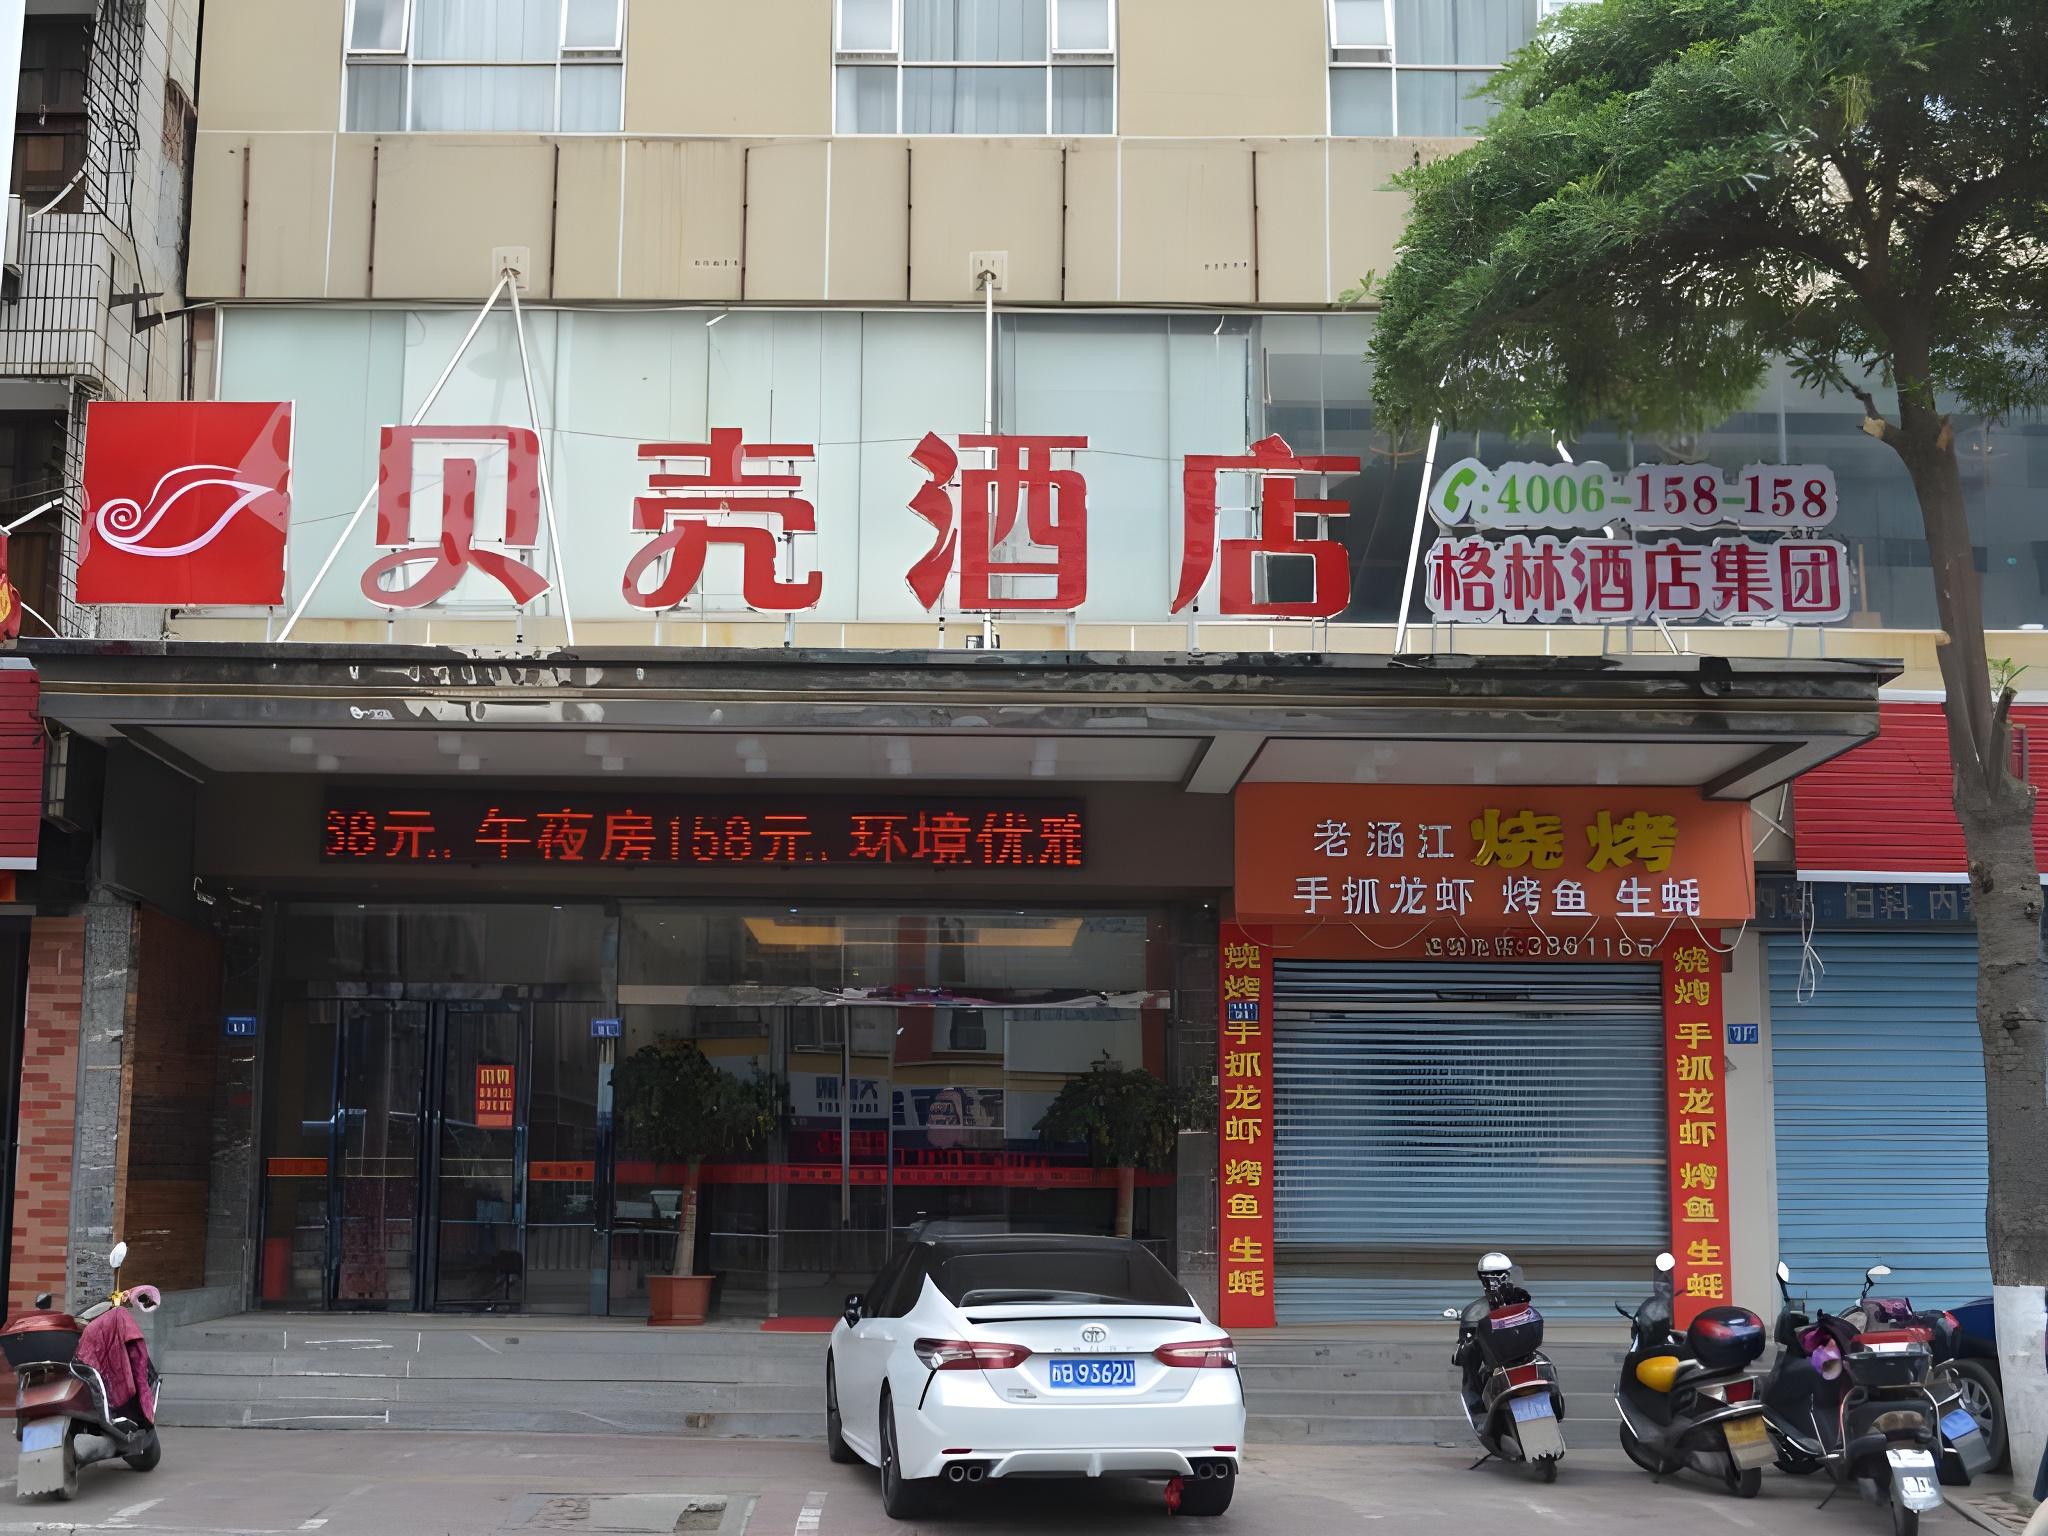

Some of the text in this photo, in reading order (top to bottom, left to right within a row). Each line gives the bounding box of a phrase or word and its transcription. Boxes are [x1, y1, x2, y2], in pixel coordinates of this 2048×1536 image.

[361, 424, 1361, 617] 贝壳酒店
[1434, 544, 1842, 613] 格林酒店集团
[1313, 808, 1680, 873] 老涵江 烧烤
[1293, 876, 1701, 917] 手抓龙虾 烤鱼 生蚝
[1224, 1020, 1263, 1145] 手抓龙虾
[1674, 1022, 1718, 1148] 手抓龙虾
[1225, 1158, 1264, 1220] 烤鱼
[1680, 1162, 1719, 1223] 烤鱼
[1228, 1235, 1266, 1298] 生蚝
